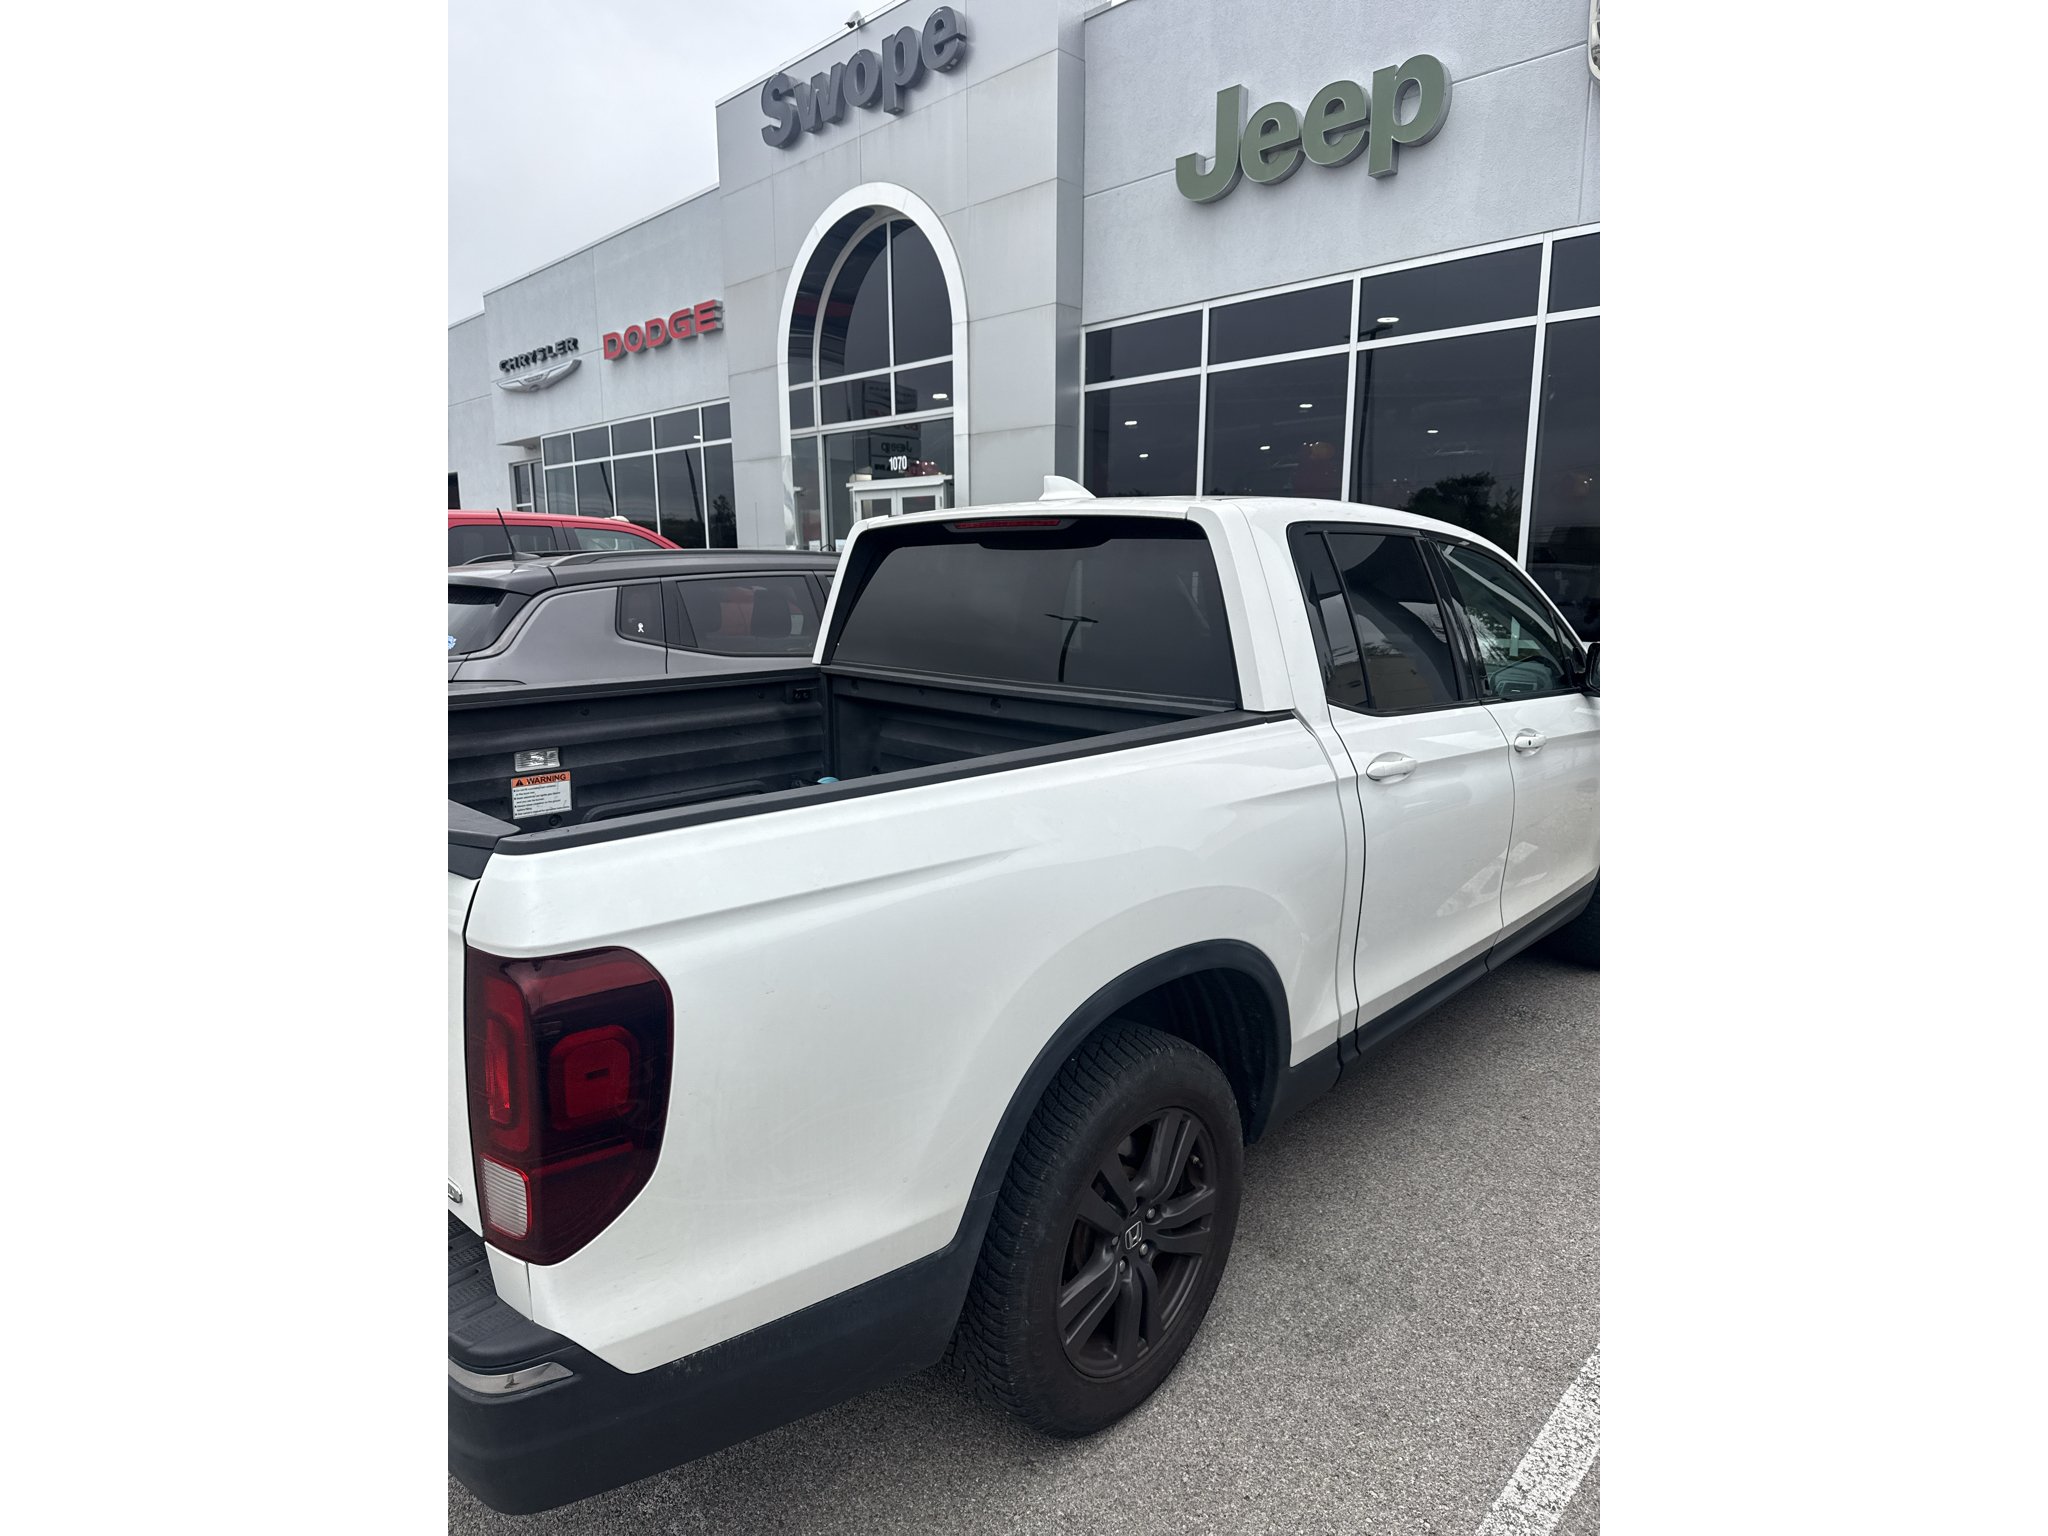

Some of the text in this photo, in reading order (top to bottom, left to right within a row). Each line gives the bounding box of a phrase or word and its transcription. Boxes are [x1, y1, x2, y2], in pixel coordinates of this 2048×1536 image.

[761, 6, 967, 148] Swope
[1176, 54, 1452, 204] Jeep
[603, 299, 724, 360] DODGE
[499, 337, 579, 372] CHRYSLER
[889, 456, 907, 471] 1070
[526, 773, 567, 785] WARNING
